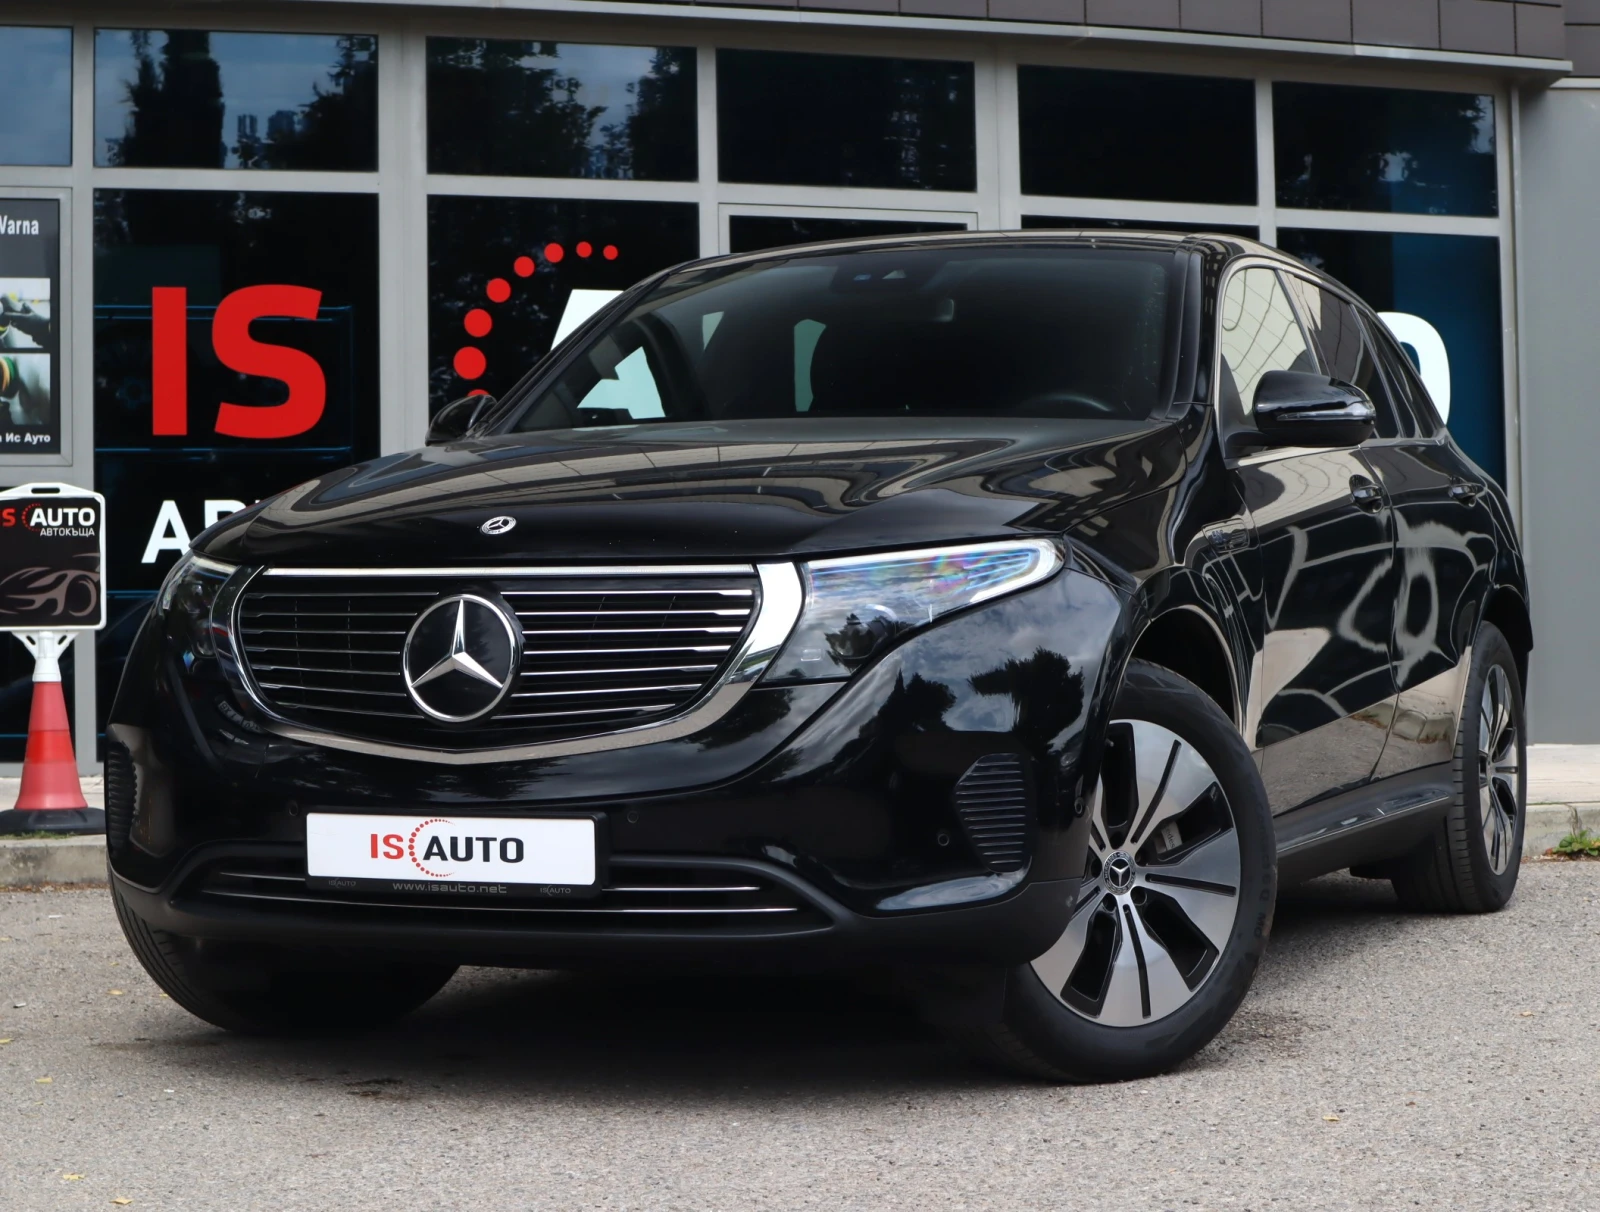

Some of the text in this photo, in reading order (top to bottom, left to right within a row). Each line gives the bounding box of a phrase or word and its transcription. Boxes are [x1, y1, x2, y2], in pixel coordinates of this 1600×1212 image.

[0, 215, 39, 235] Varna
[152, 284, 327, 439] IS
[5, 432, 21, 443] Ис
[24, 432, 51, 445] Ауто
[0, 507, 95, 527] S AUTO
[40, 527, 95, 537] АВТОКЪЩА
[370, 833, 525, 864] IS AUTO
[392, 881, 508, 895] www.isauto.net
